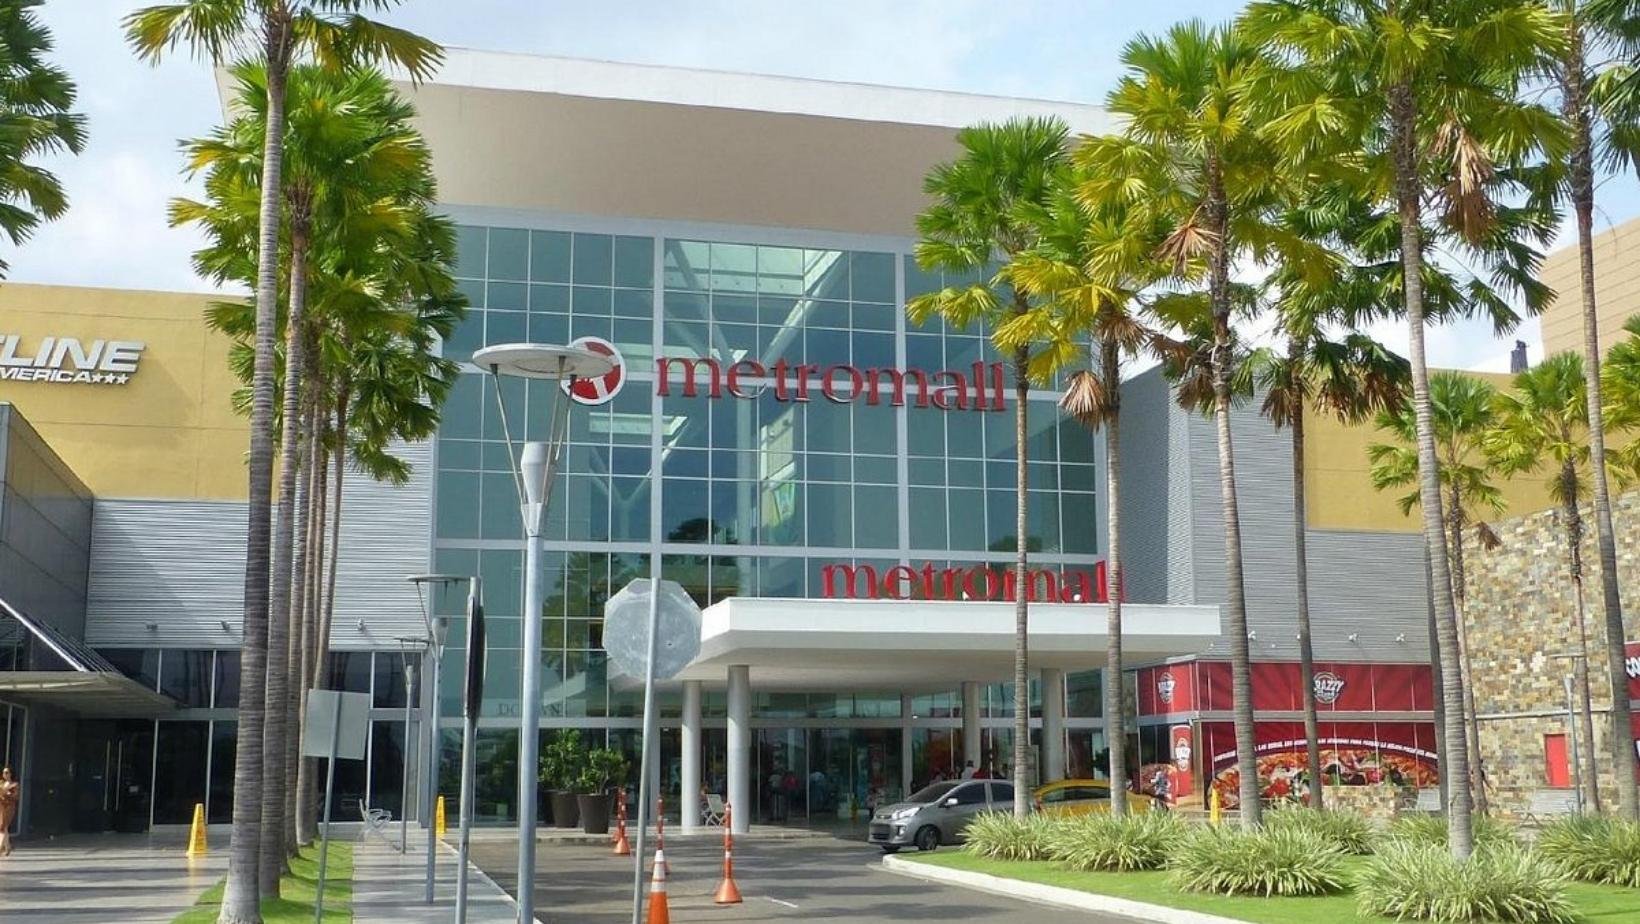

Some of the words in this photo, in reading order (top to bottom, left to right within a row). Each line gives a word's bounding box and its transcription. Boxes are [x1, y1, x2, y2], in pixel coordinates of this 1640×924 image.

[0, 334, 145, 373] LINE
[656, 357, 1005, 412] metromall
[821, 560, 1124, 604] metromal
